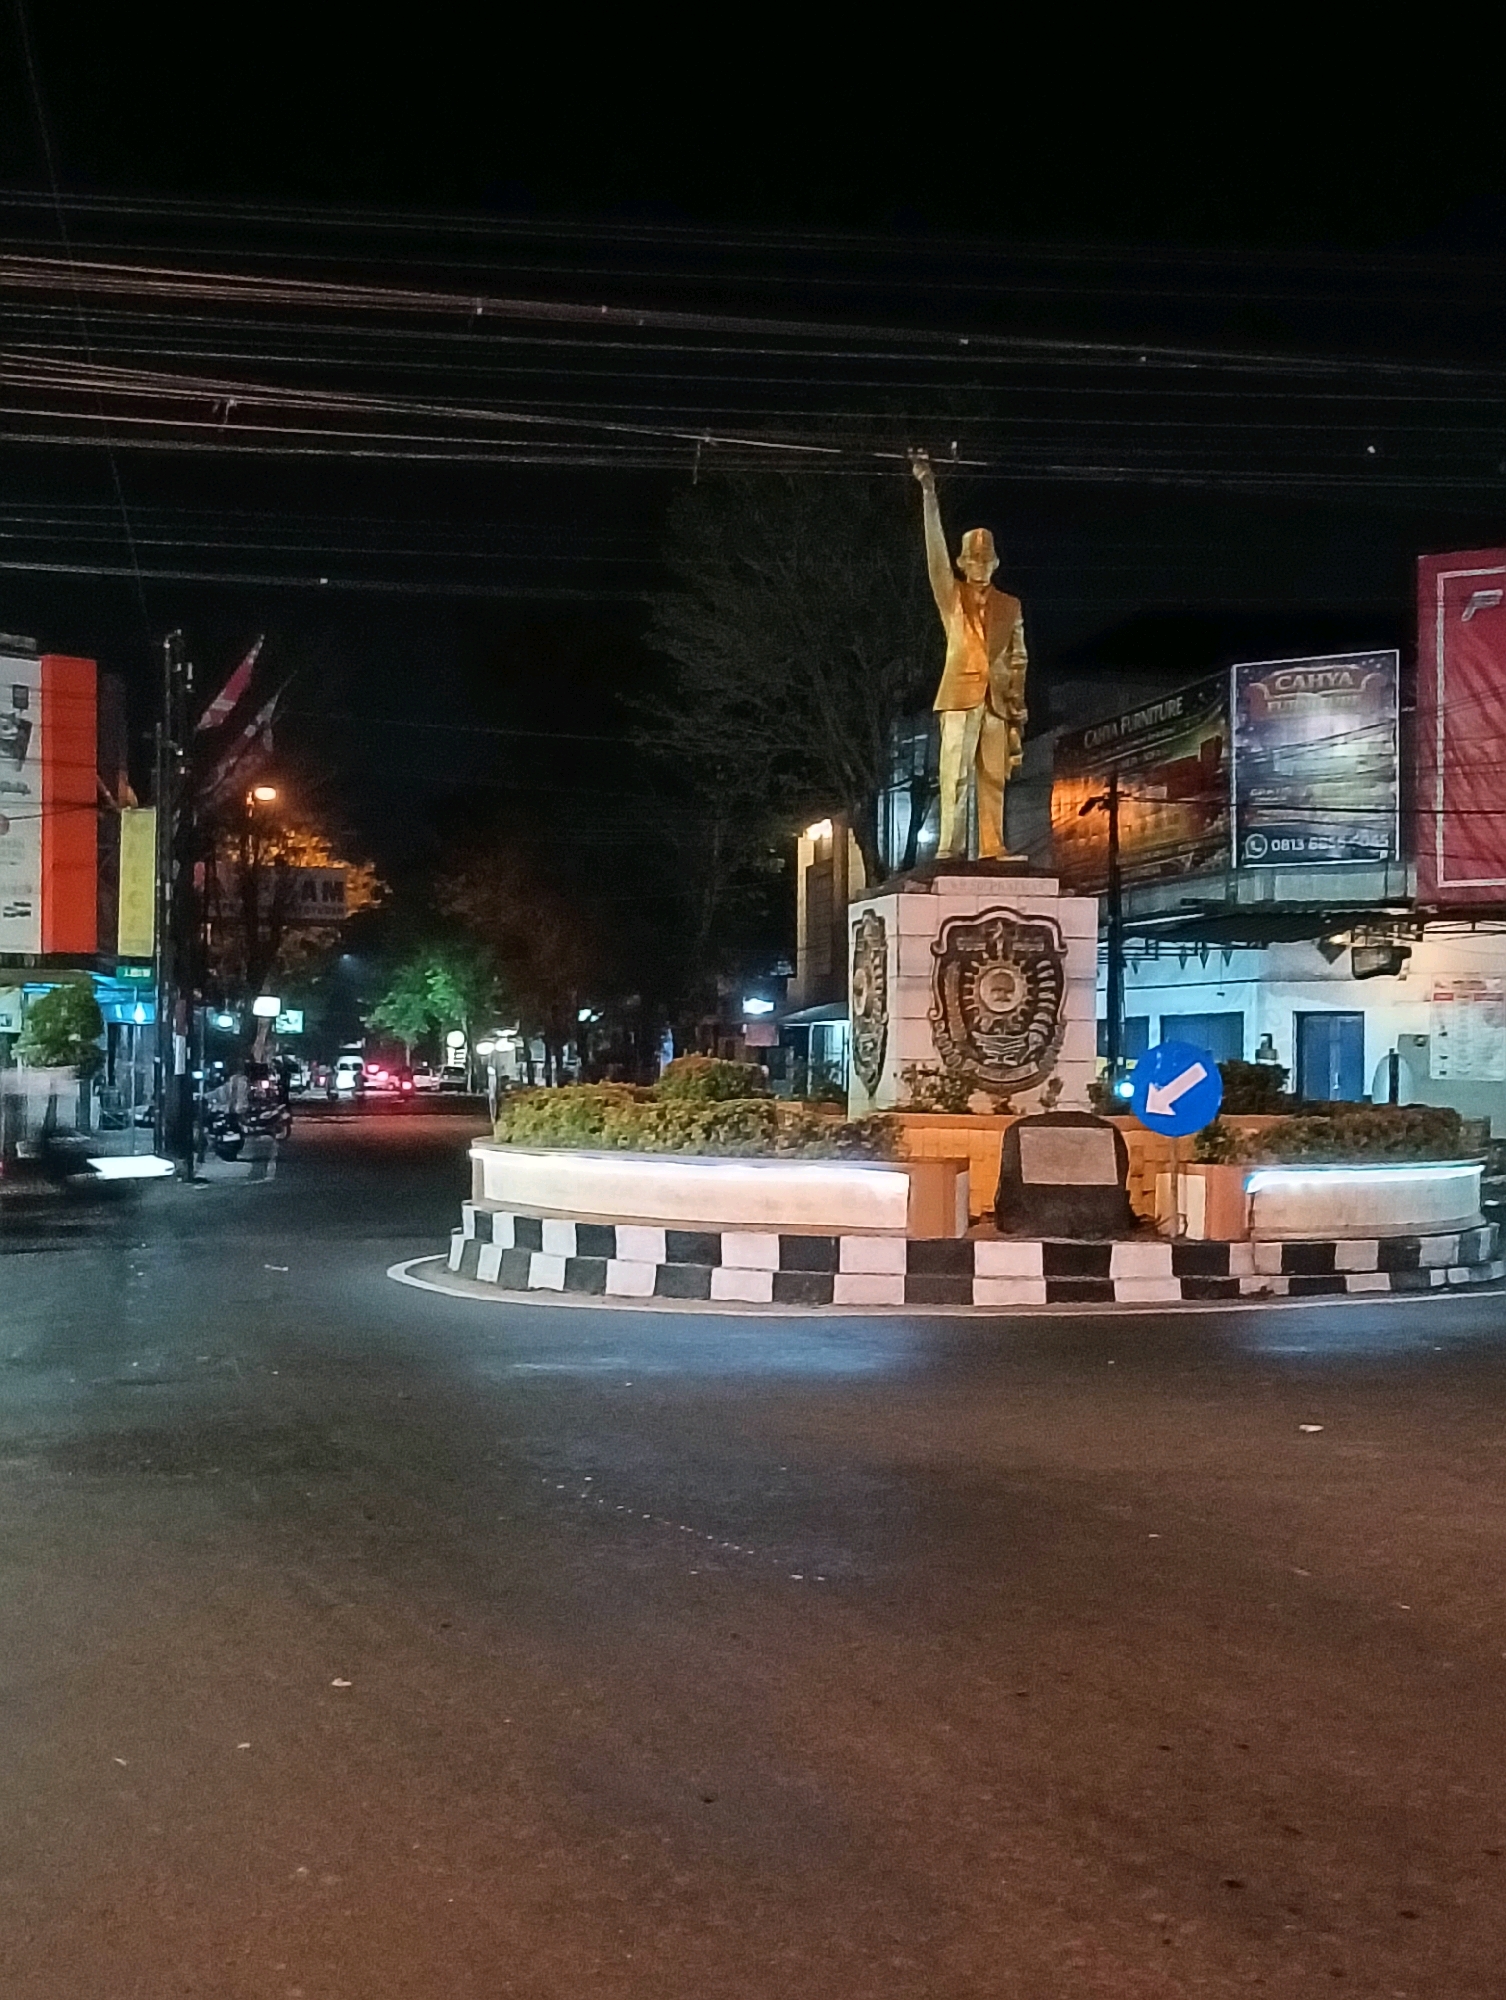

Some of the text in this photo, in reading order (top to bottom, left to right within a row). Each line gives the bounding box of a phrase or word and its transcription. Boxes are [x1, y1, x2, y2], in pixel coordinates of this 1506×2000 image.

[1275, 671, 1354, 691] CAHYA
[1121, 696, 1183, 735] FURNITURE
[1271, 838, 1304, 851] 0813
